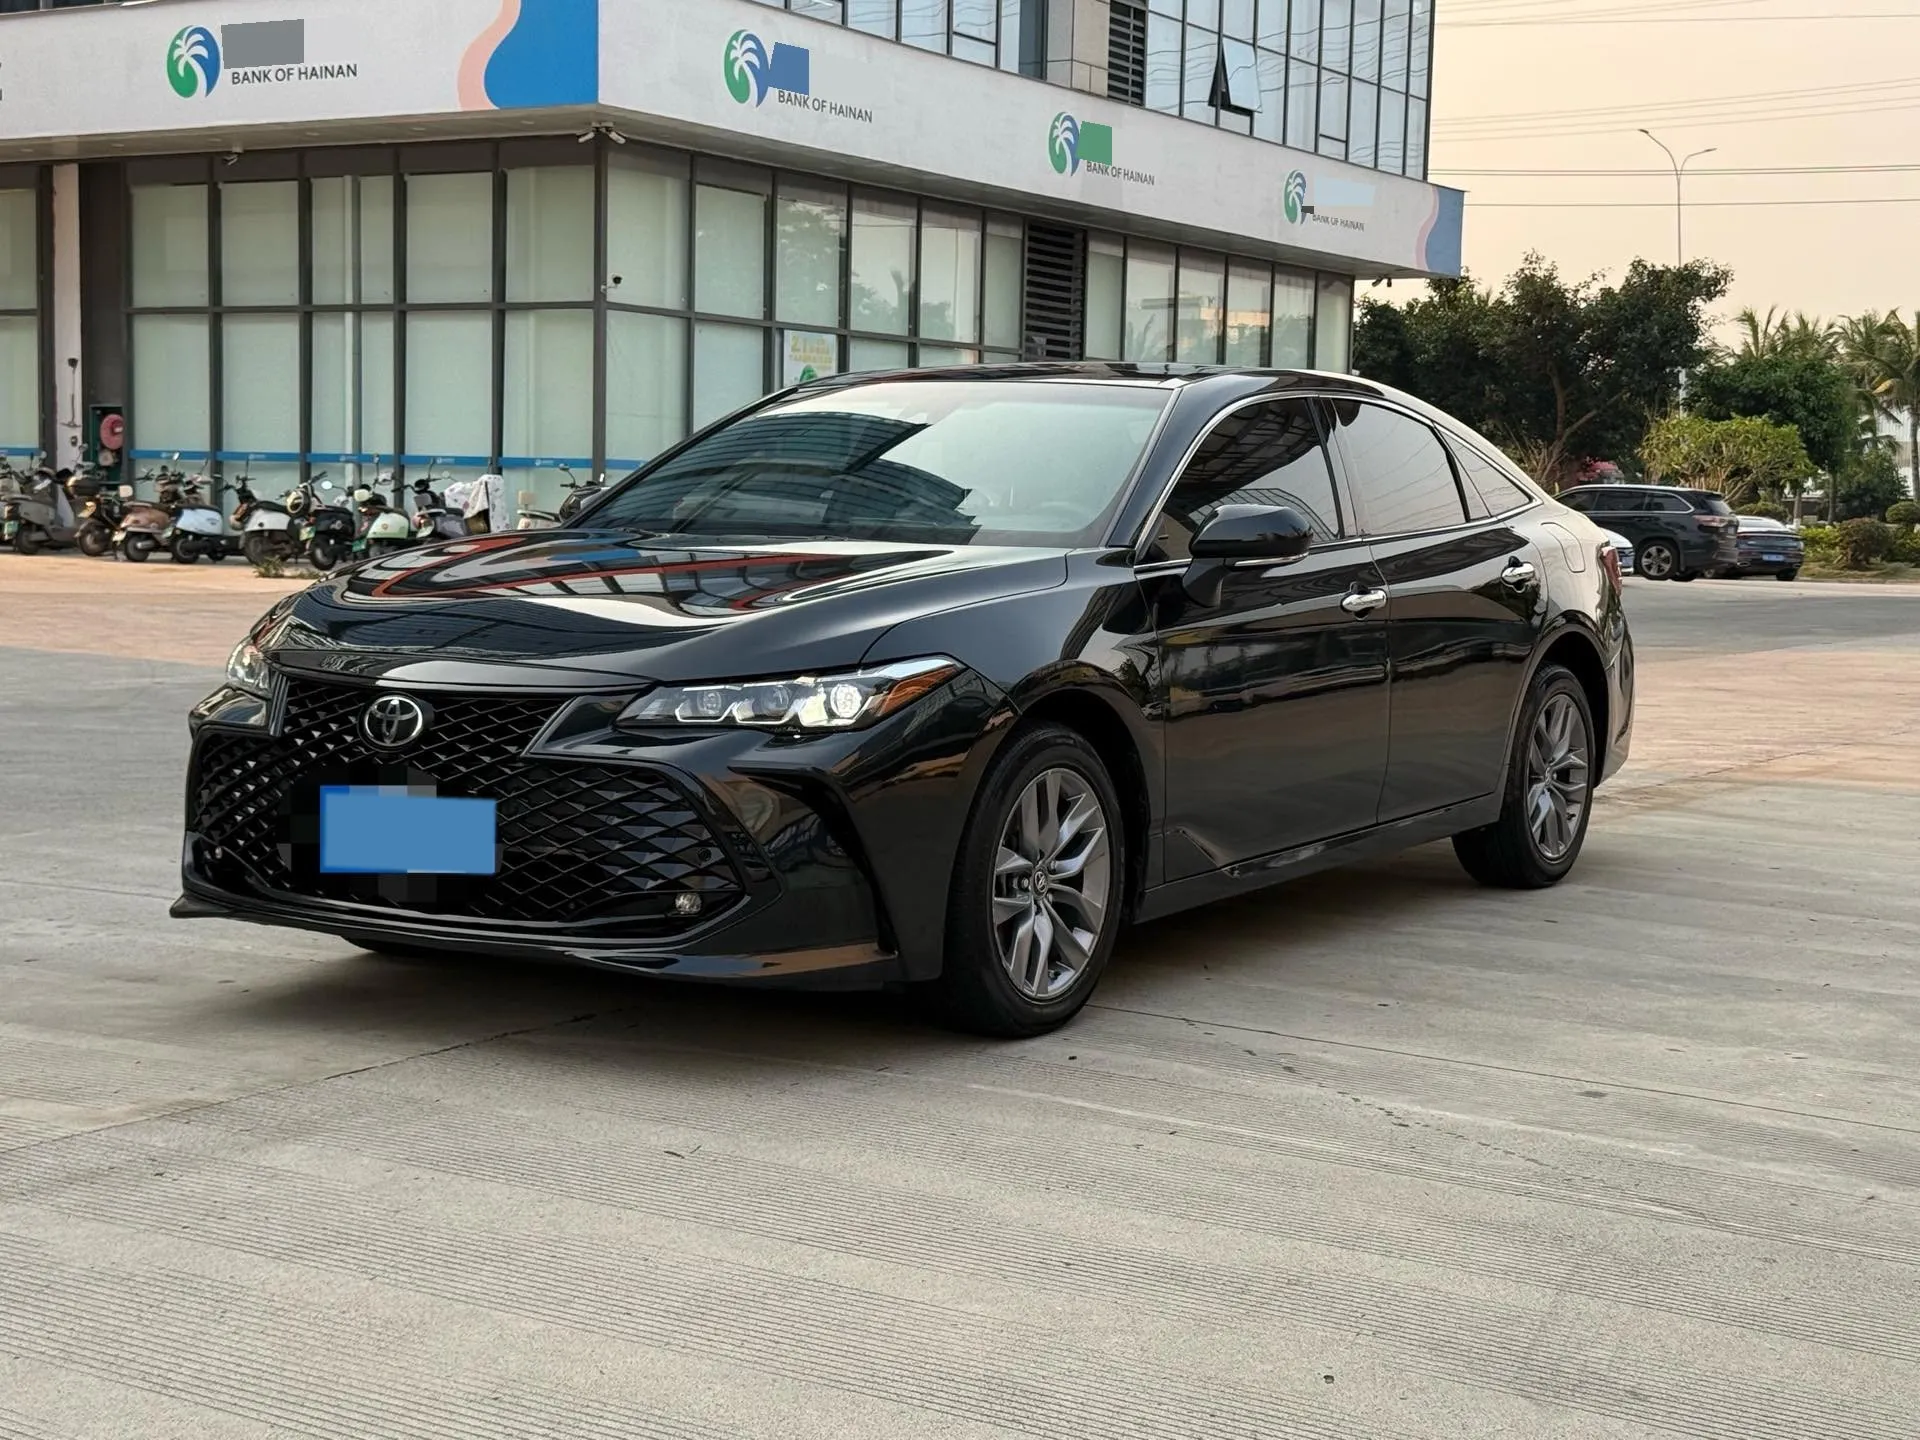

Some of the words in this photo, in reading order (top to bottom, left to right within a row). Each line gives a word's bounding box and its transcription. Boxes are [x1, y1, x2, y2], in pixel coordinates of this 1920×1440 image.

[232, 69, 272, 85] BANK
[275, 68, 294, 81] OF
[298, 64, 358, 80] HAINAN
[778, 90, 810, 109] BANK
[812, 98, 827, 112] OF
[829, 102, 873, 123] HAINAN
[1086, 161, 1110, 176] BANK
[1111, 166, 1122, 179] OF
[1123, 169, 1155, 185] HAINAN
